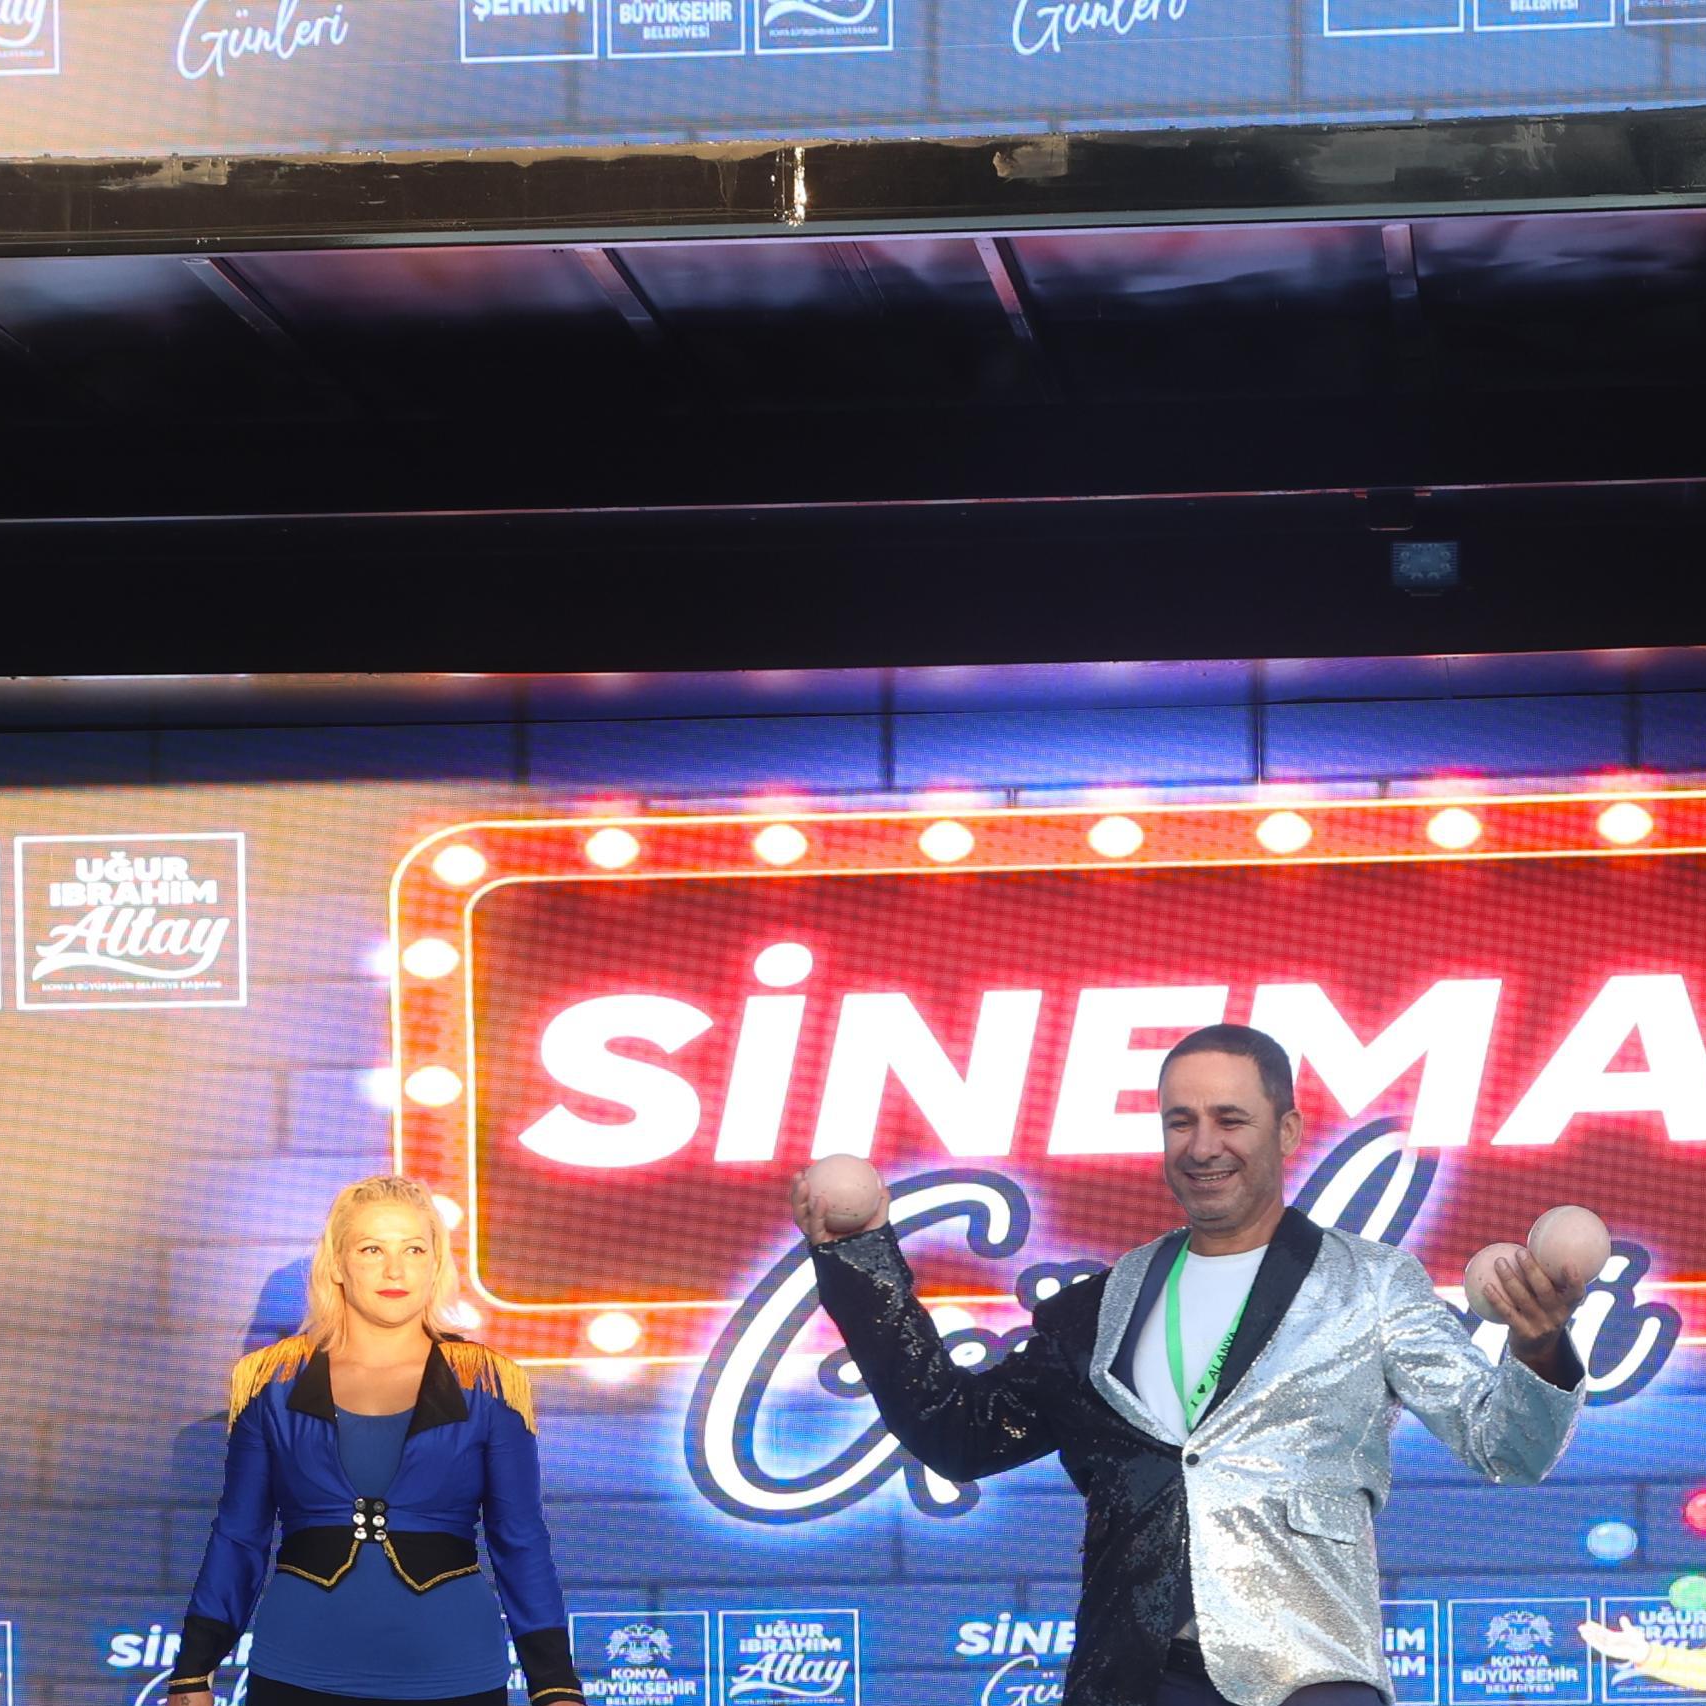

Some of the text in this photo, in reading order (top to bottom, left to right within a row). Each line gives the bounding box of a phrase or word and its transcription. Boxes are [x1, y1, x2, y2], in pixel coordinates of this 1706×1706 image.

[75, 851, 189, 882] UĞUR
[32, 905, 230, 982] Altay
[1207, 1331, 1239, 1382] ALANYA
[755, 1620, 823, 1638] UĞUR
[954, 1612, 1076, 1656] SİNE
[611, 1668, 668, 1680] KONYA
[1461, 1664, 1579, 1685] BÜYÜKŞEHİR
[1491, 1655, 1549, 1668] KONYA
[583, 1678, 697, 1697] BÜYÜKŞEHİR
[729, 1653, 850, 1697] Altay
